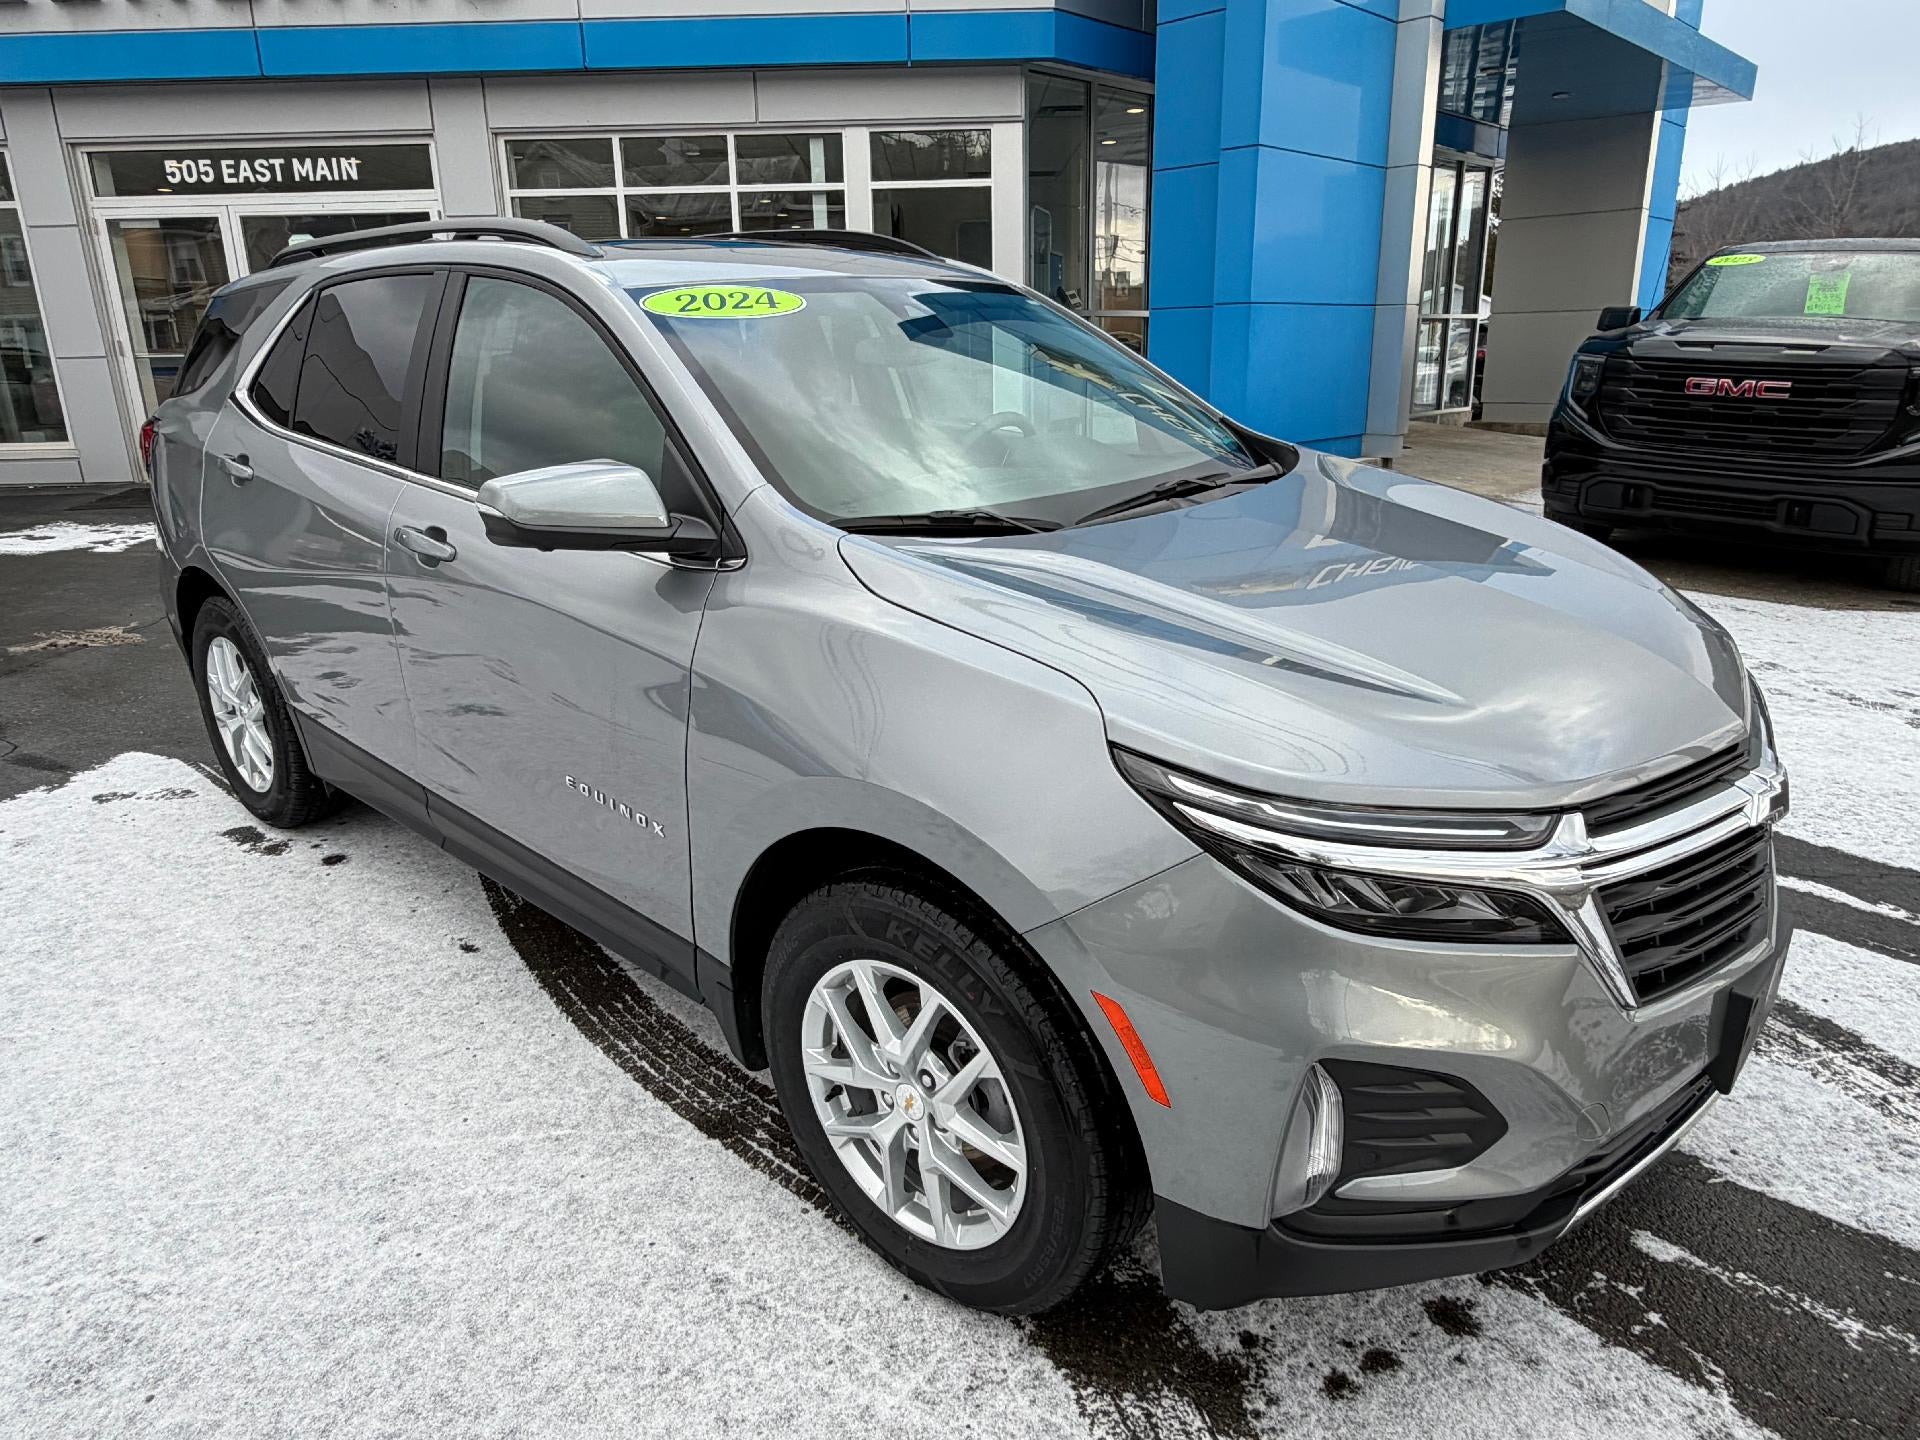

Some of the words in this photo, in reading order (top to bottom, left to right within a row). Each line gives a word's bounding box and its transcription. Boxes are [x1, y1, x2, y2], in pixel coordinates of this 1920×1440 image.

[164, 159, 215, 184] 505
[221, 158, 285, 183] EAST
[292, 157, 360, 182] MAIN
[675, 291, 781, 313] 2024
[1684, 377, 1792, 399] GMC
[565, 774, 666, 838] EQUINOX
[885, 919, 1006, 1017] KELLY
